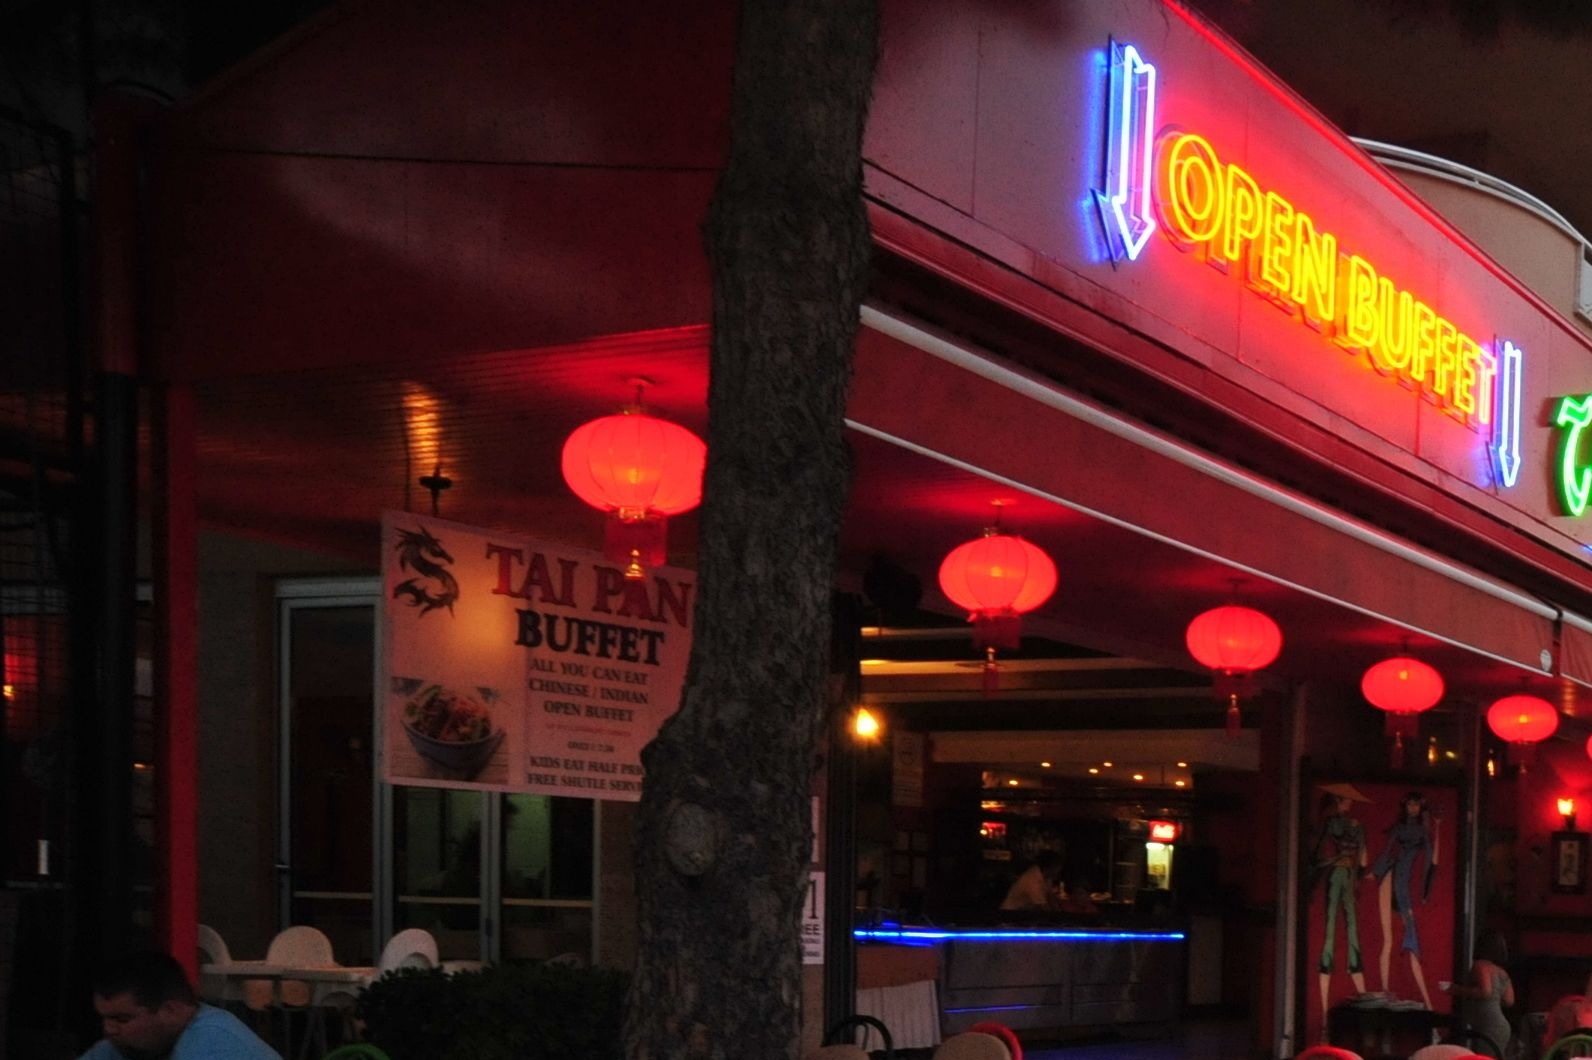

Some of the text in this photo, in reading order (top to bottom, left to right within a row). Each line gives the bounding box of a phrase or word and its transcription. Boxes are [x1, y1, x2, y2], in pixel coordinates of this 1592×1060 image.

[1167, 132, 1499, 426] OPEN BUFFET
[485, 542, 693, 628] TAI PAN
[514, 607, 666, 666] BUFFET
[530, 658, 648, 685] ALL YOU CAN EAT
[528, 678, 590, 698] CHINESE
[600, 687, 648, 704] INDIAN
[544, 700, 634, 722] OPEN BUFFET
[530, 756, 561, 769] KIDS
[563, 759, 585, 771] EAT
[587, 761, 618, 774] HALF
[527, 773, 557, 786] FREE
